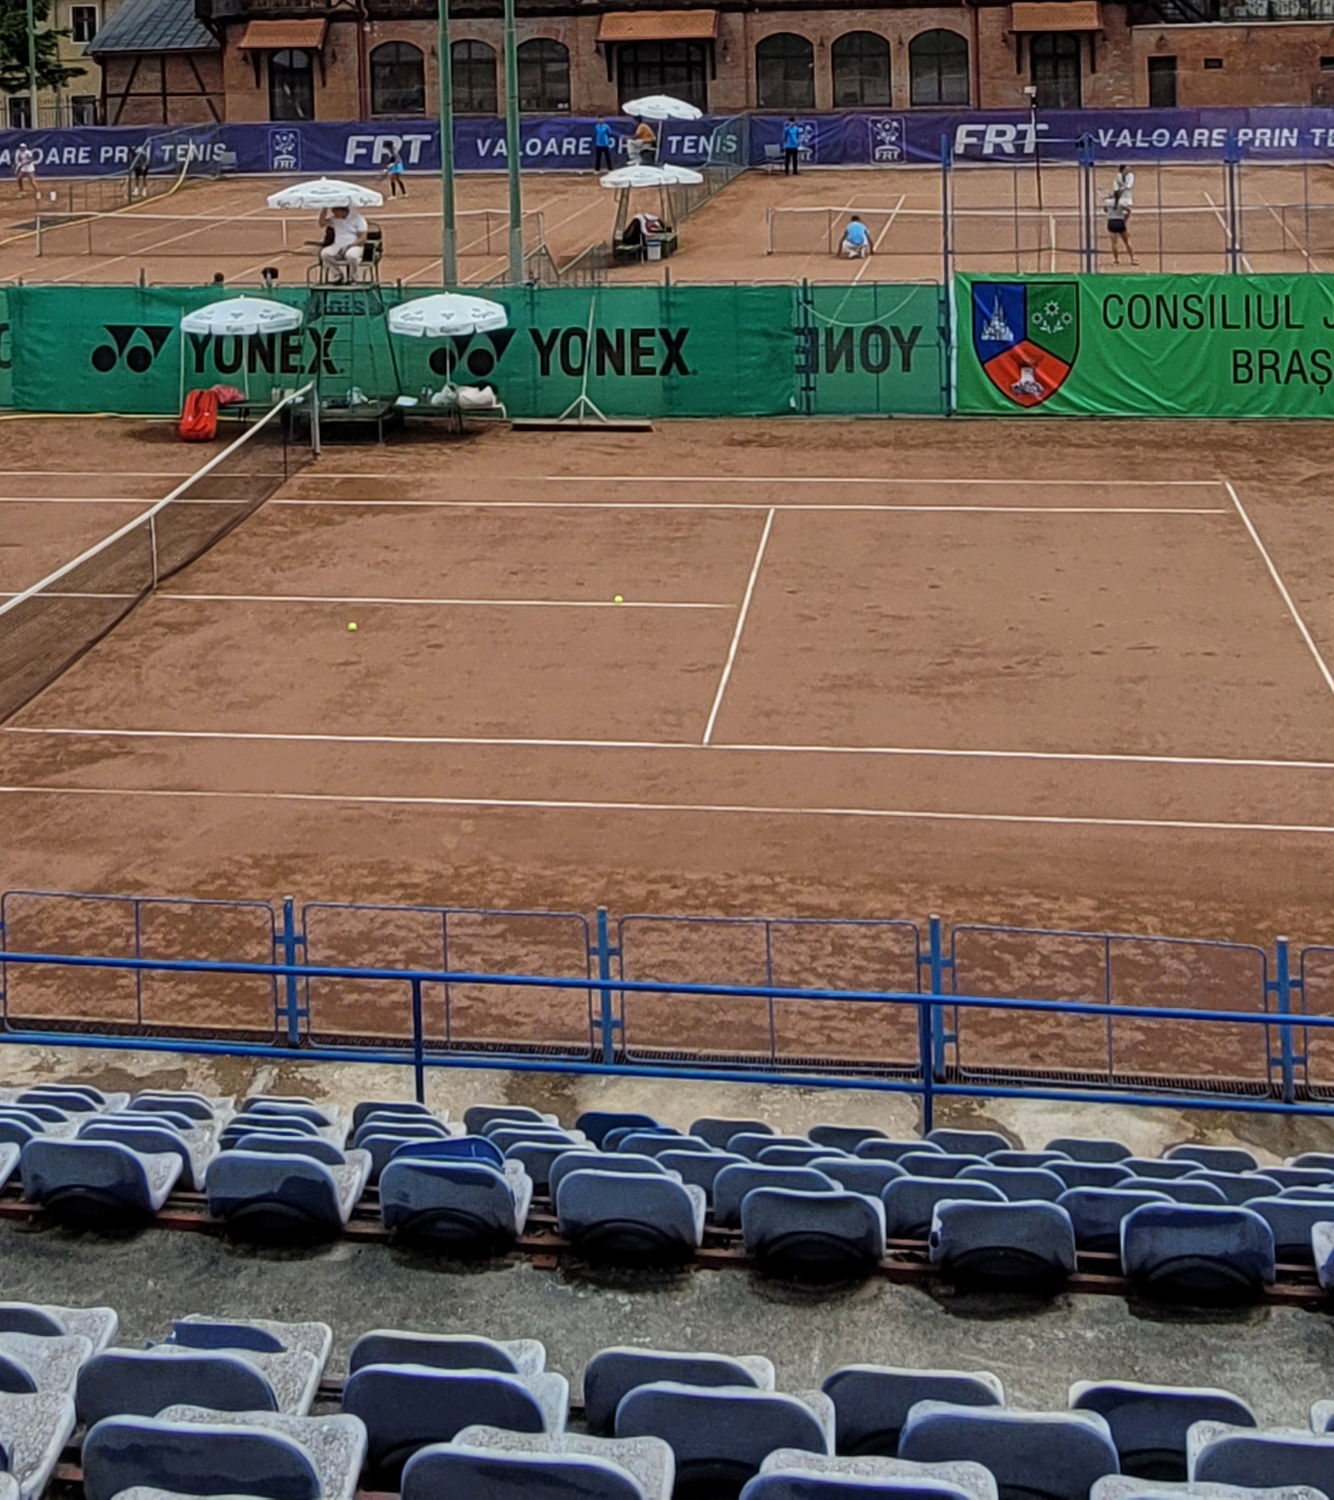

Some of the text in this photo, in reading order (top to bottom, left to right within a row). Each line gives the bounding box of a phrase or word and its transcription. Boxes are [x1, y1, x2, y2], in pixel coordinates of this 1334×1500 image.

[345, 134, 432, 164] FRT
[477, 137, 592, 157] VAOARE
[667, 135, 738, 154] TENIS
[955, 123, 1049, 154] FRT
[1098, 128, 1227, 148] VALOARE
[1237, 128, 1298, 147] PRIN
[100, 145, 151, 164] PRN
[161, 143, 227, 162] TENIS
[875, 150, 901, 161] FRT
[1102, 293, 1305, 330] CONSILIUL
[188, 326, 338, 375] YONEX
[528, 326, 690, 377] YONEX
